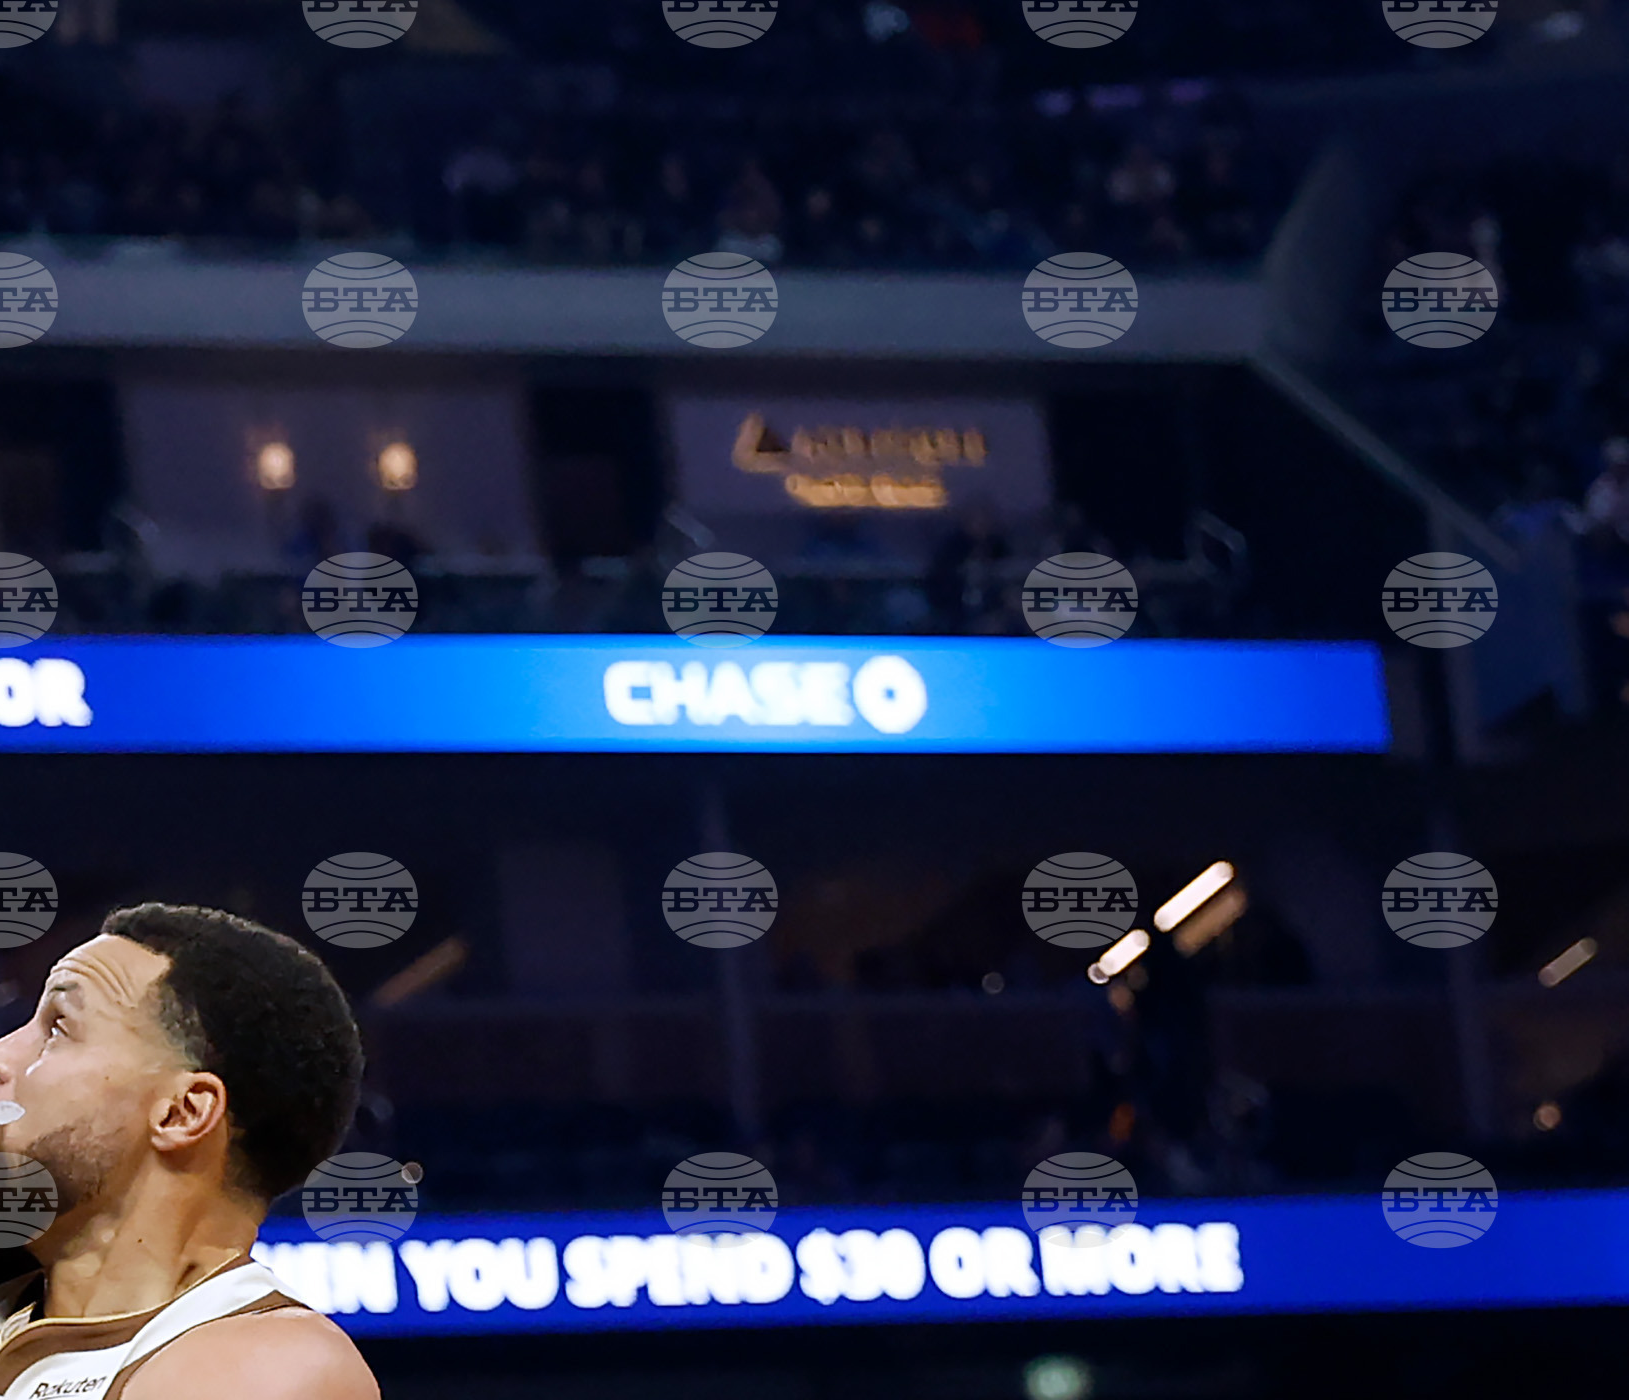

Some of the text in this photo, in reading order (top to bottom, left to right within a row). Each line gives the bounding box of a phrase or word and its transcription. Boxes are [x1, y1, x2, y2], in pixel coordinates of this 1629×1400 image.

[603, 661, 855, 725] CHASE
[398, 1237, 560, 1313] YOU
[562, 1232, 795, 1310] SPEND
[928, 1226, 1042, 1299] OR
[1038, 1221, 1245, 1297] MORE
